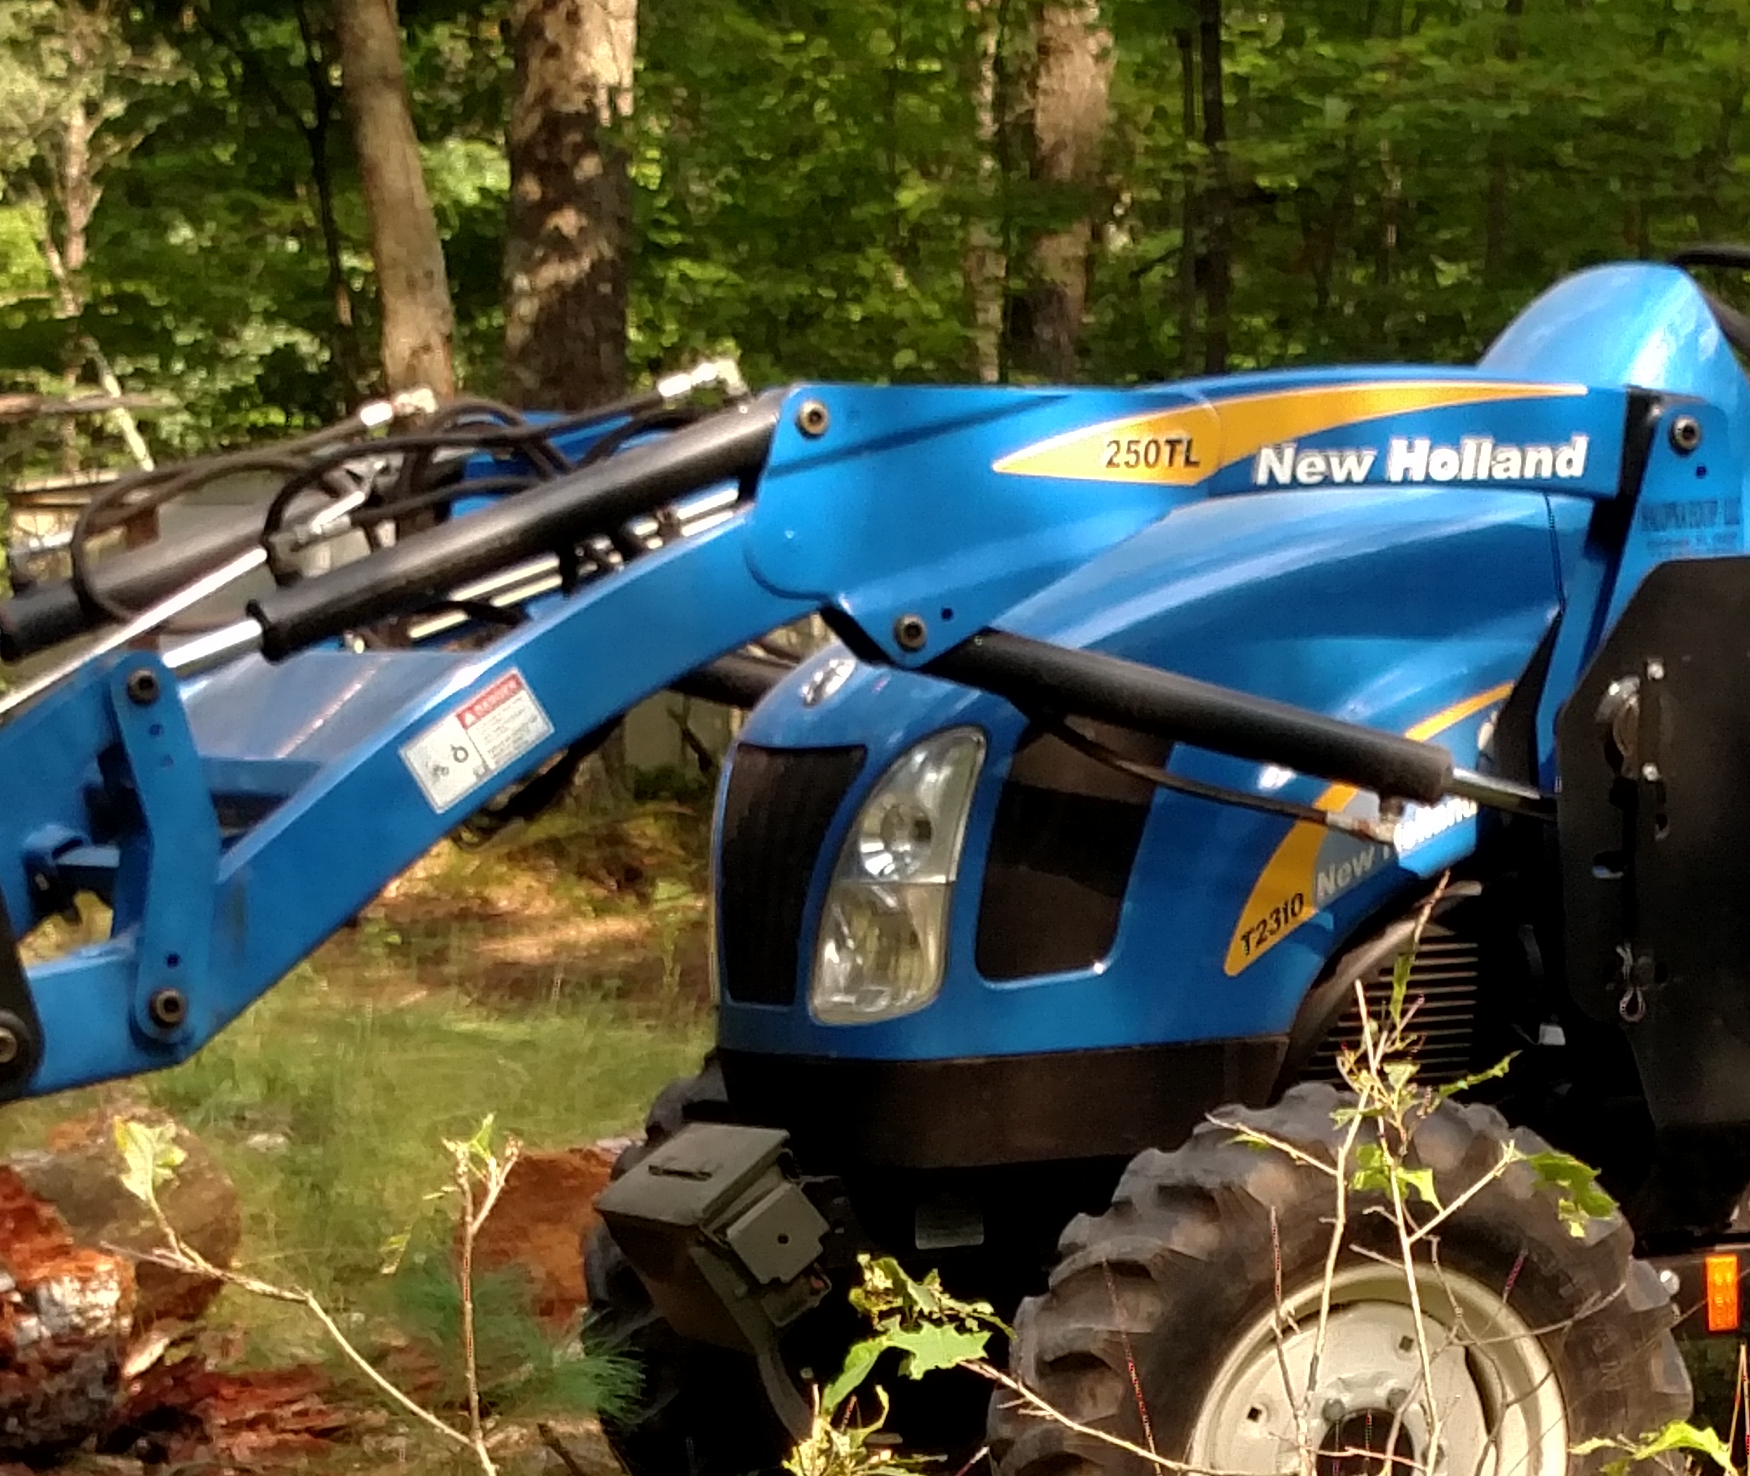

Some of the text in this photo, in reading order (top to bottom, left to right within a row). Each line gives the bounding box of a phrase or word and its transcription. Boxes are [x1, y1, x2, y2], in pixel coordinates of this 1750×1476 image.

[1105, 437, 1200, 469] 250TL
[1254, 434, 1589, 485] New Holland
[1316, 846, 1376, 900] New
[1240, 892, 1305, 956] T2310
